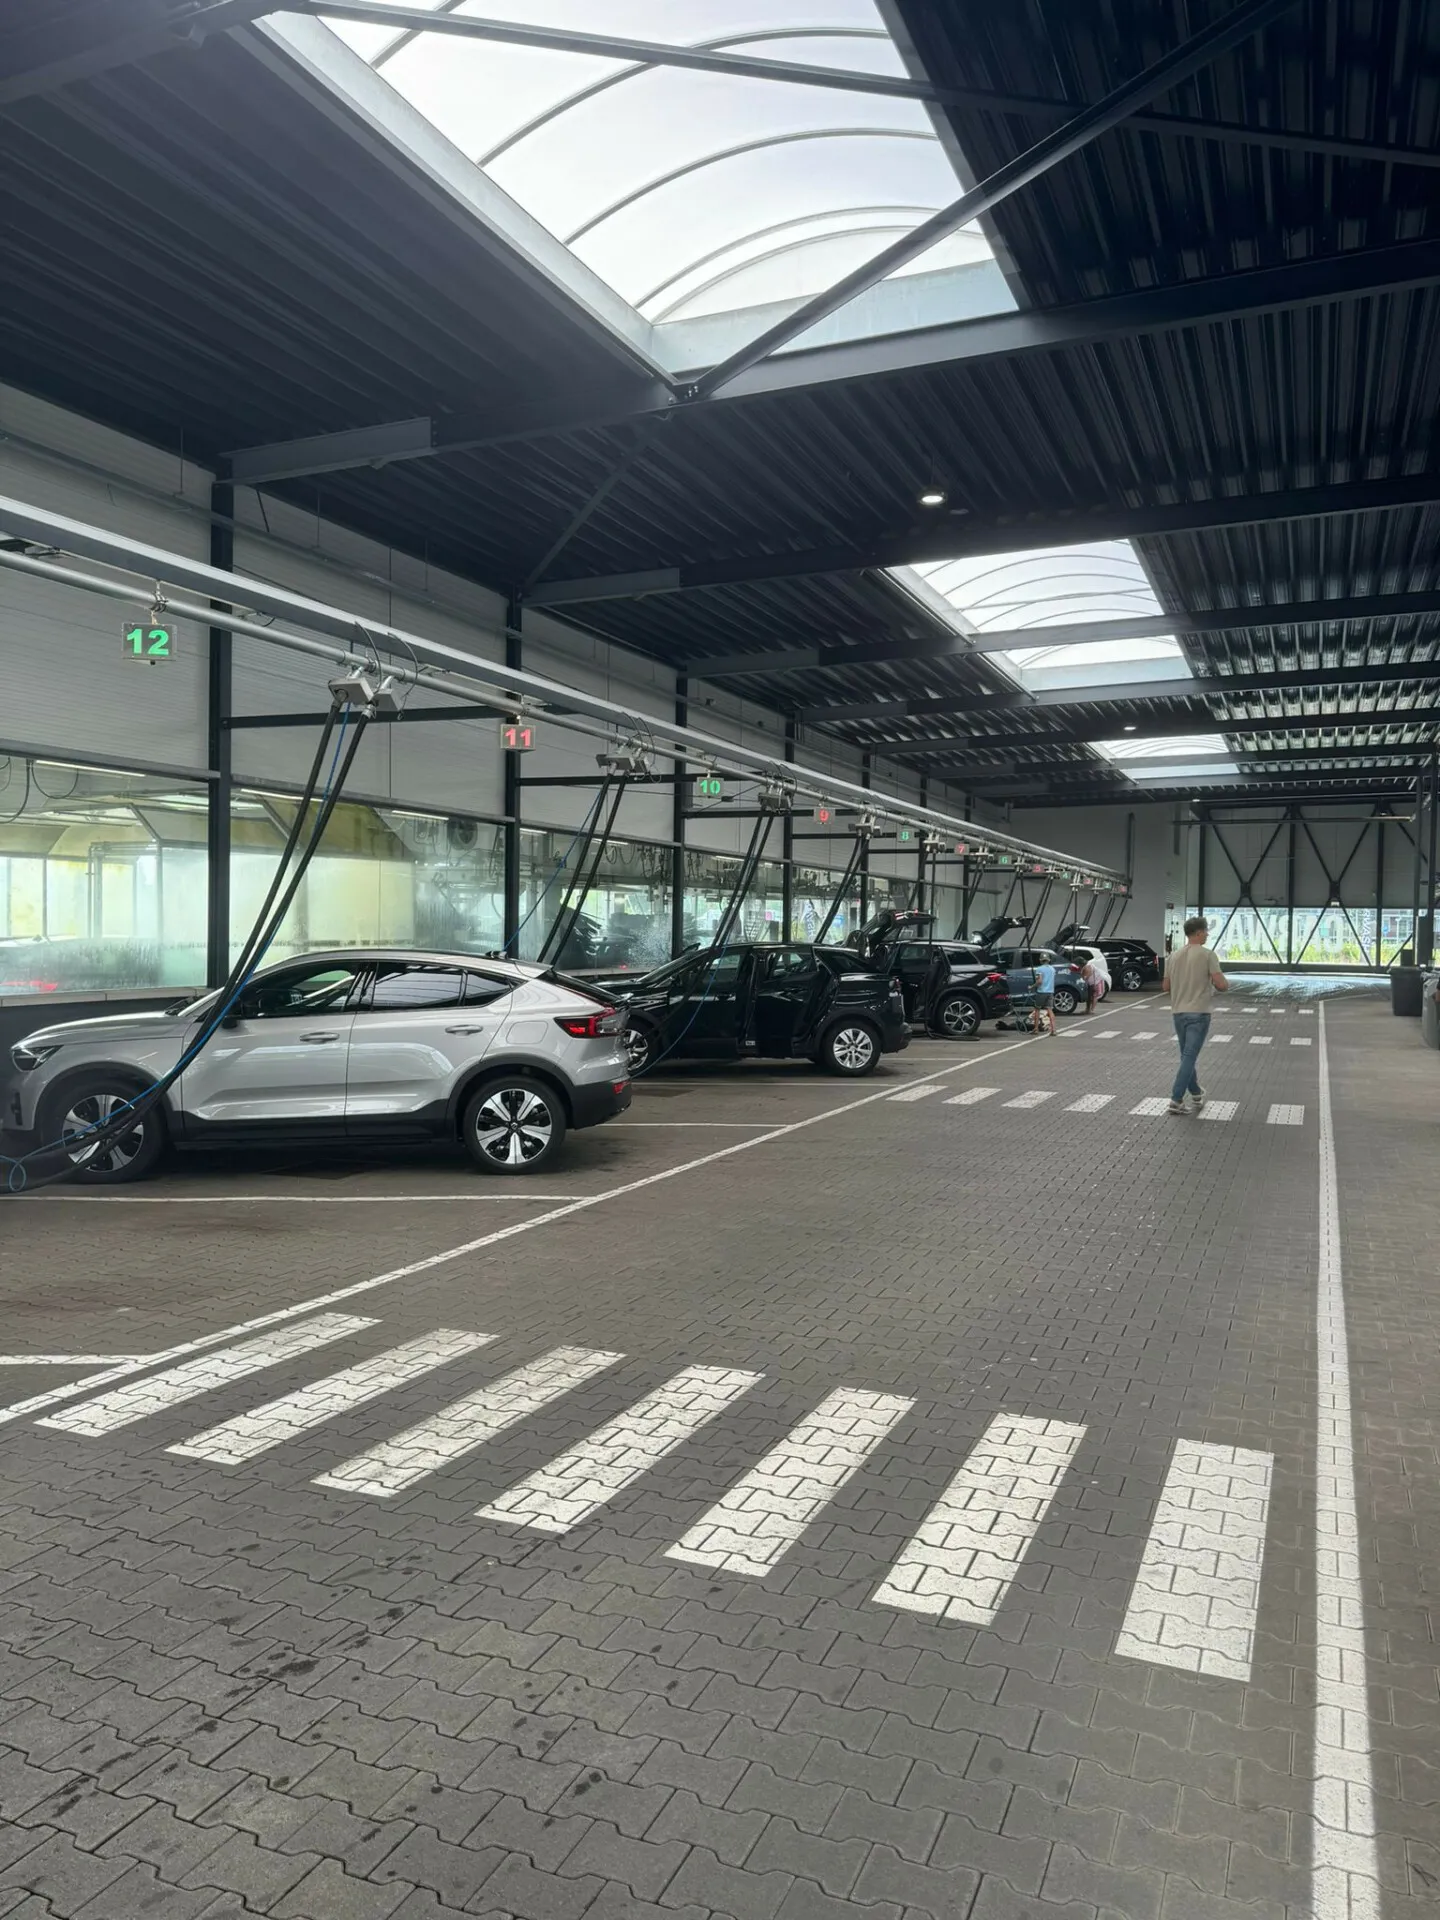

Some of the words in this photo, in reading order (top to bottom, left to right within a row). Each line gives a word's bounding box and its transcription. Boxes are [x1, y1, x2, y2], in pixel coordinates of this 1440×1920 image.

[127, 628, 169, 655] 12
[504, 728, 531, 747] 11
[700, 780, 720, 795] 10
[819, 809, 829, 821] 9
[901, 831, 909, 841] 8
[958, 844, 965, 854] 7
[1001, 856, 1008, 864] 6
